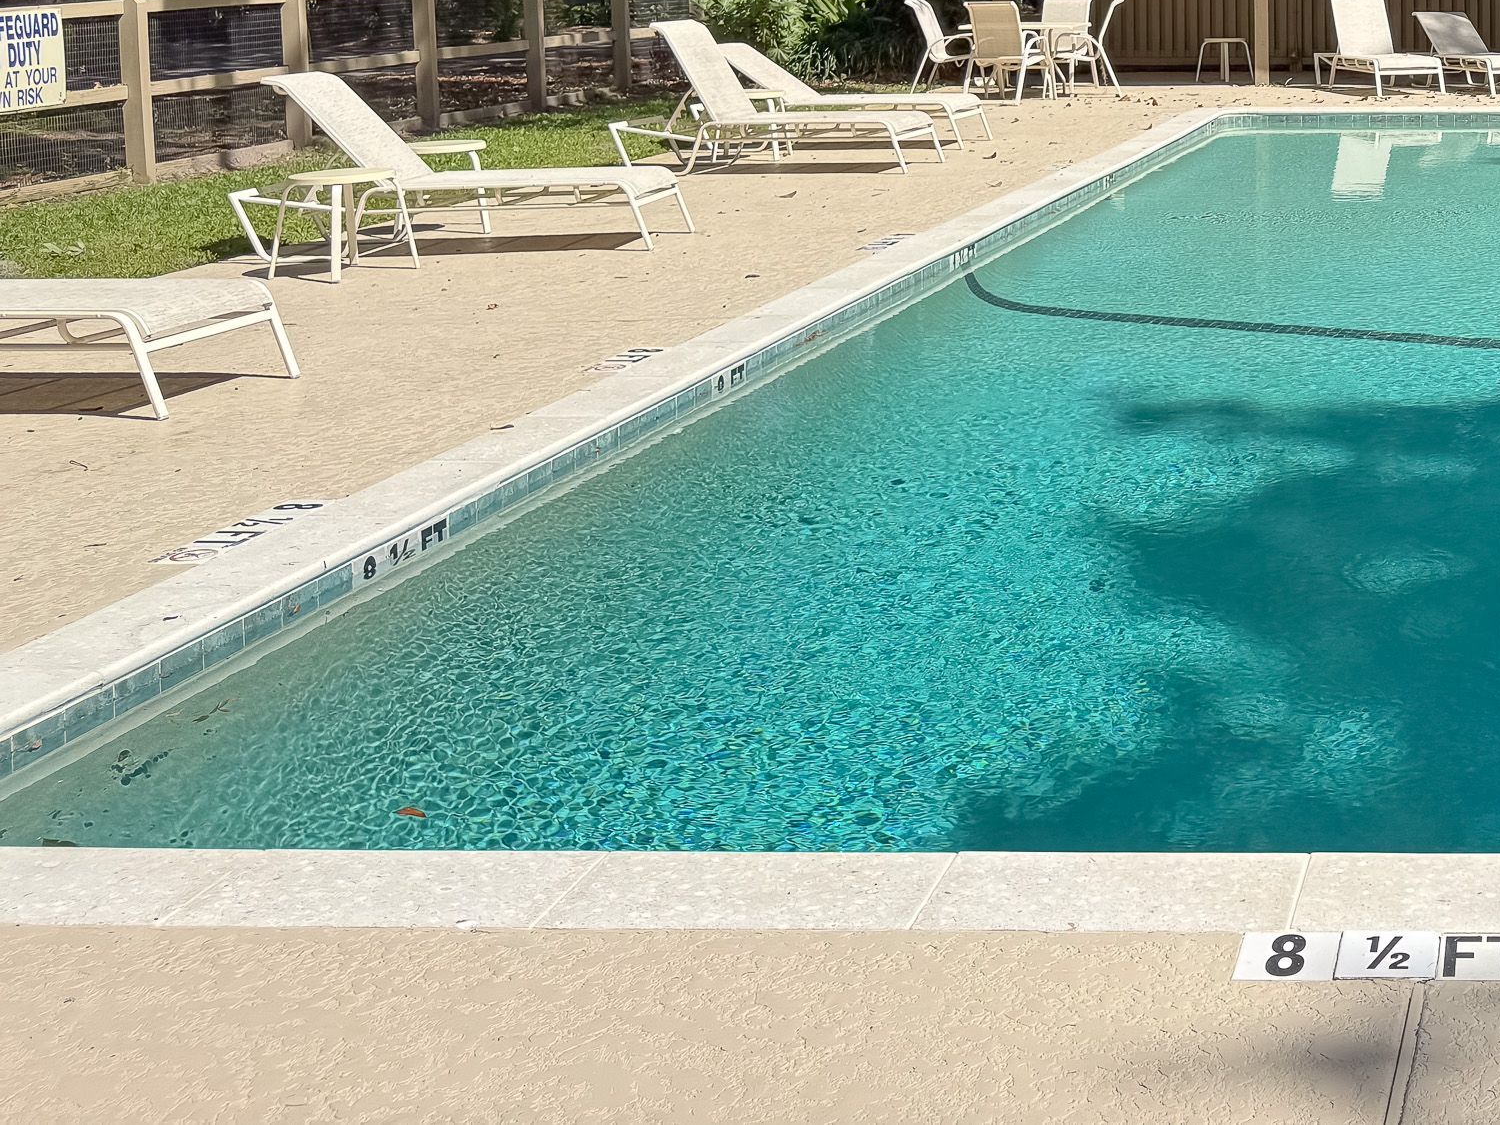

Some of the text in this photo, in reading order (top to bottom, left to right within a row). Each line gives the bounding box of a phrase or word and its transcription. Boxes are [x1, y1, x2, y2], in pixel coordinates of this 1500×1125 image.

[8, 40, 41, 67] DUTY
[5, 67, 57, 89] AT YOUR
[18, 87, 43, 107] RISK
[420, 518, 448, 552] FT
[1264, 933, 1307, 977] 8
